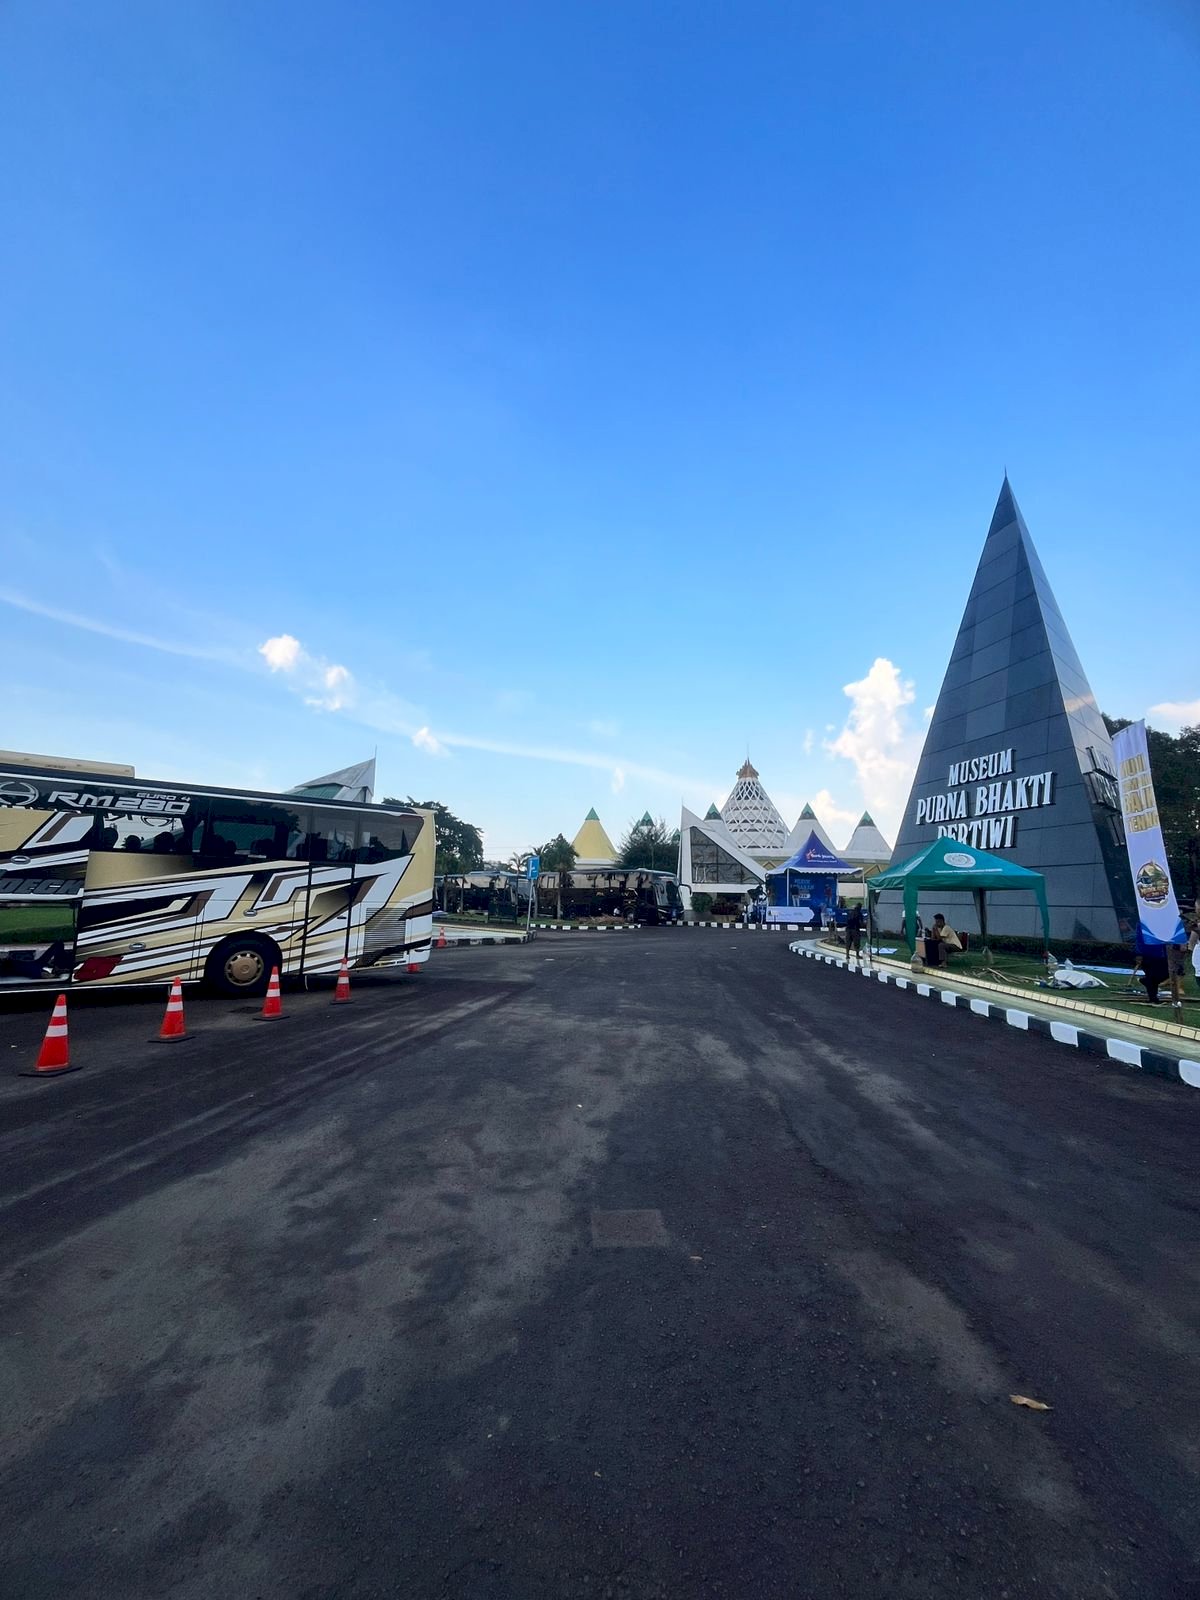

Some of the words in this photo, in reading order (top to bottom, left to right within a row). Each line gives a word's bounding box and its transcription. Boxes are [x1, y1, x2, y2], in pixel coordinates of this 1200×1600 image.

[948, 748, 1013, 787] MUSEUM
[136, 792, 177, 801] EURO
[915, 790, 967, 825] PURNA
[975, 771, 1053, 816] BHAKTI
